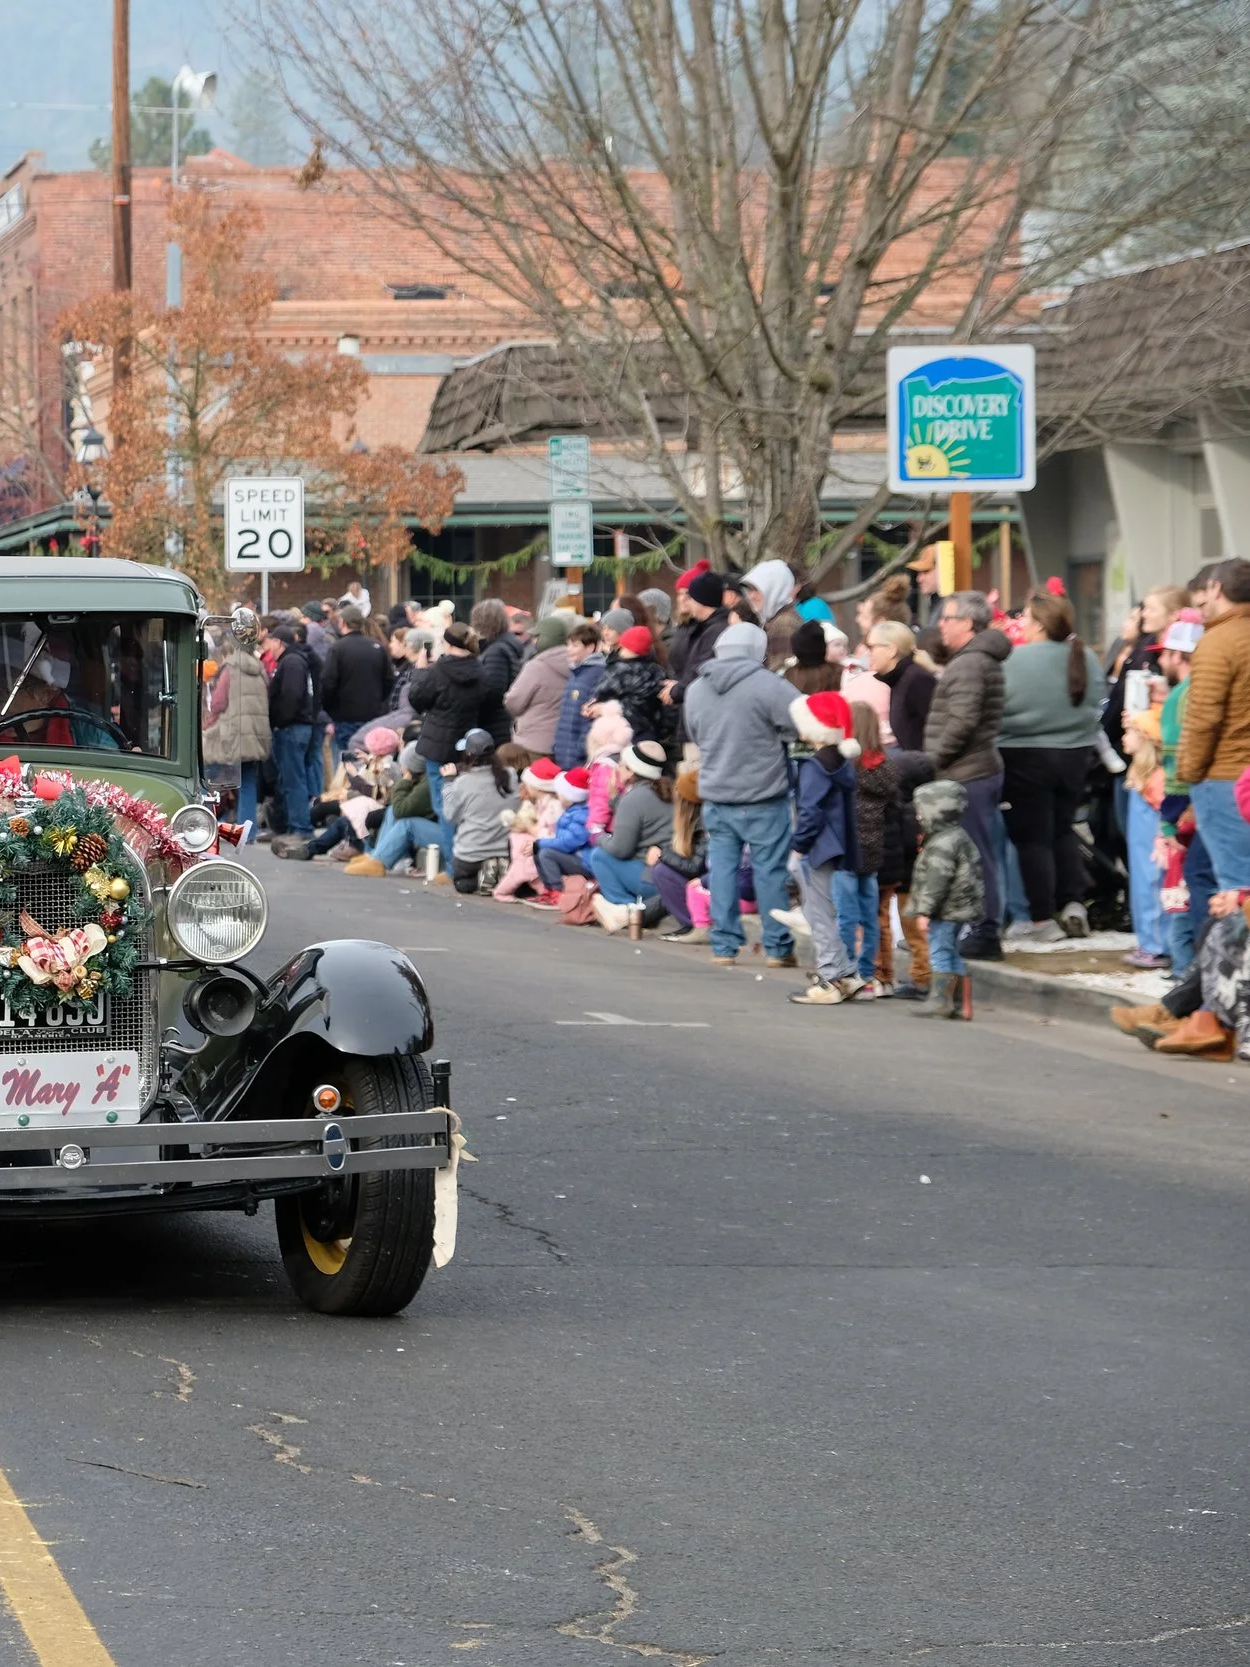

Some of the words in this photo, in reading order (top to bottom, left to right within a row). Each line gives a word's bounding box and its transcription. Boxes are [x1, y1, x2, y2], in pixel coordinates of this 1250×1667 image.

[912, 393, 1012, 418] DISCOVERY
[933, 419, 993, 441] DRIVE
[234, 489, 296, 503] SPEED
[240, 508, 288, 522] LIMIT
[237, 529, 293, 559] 20
[2, 1068, 81, 1116] Mary
[91, 1063, 131, 1104] "A"
